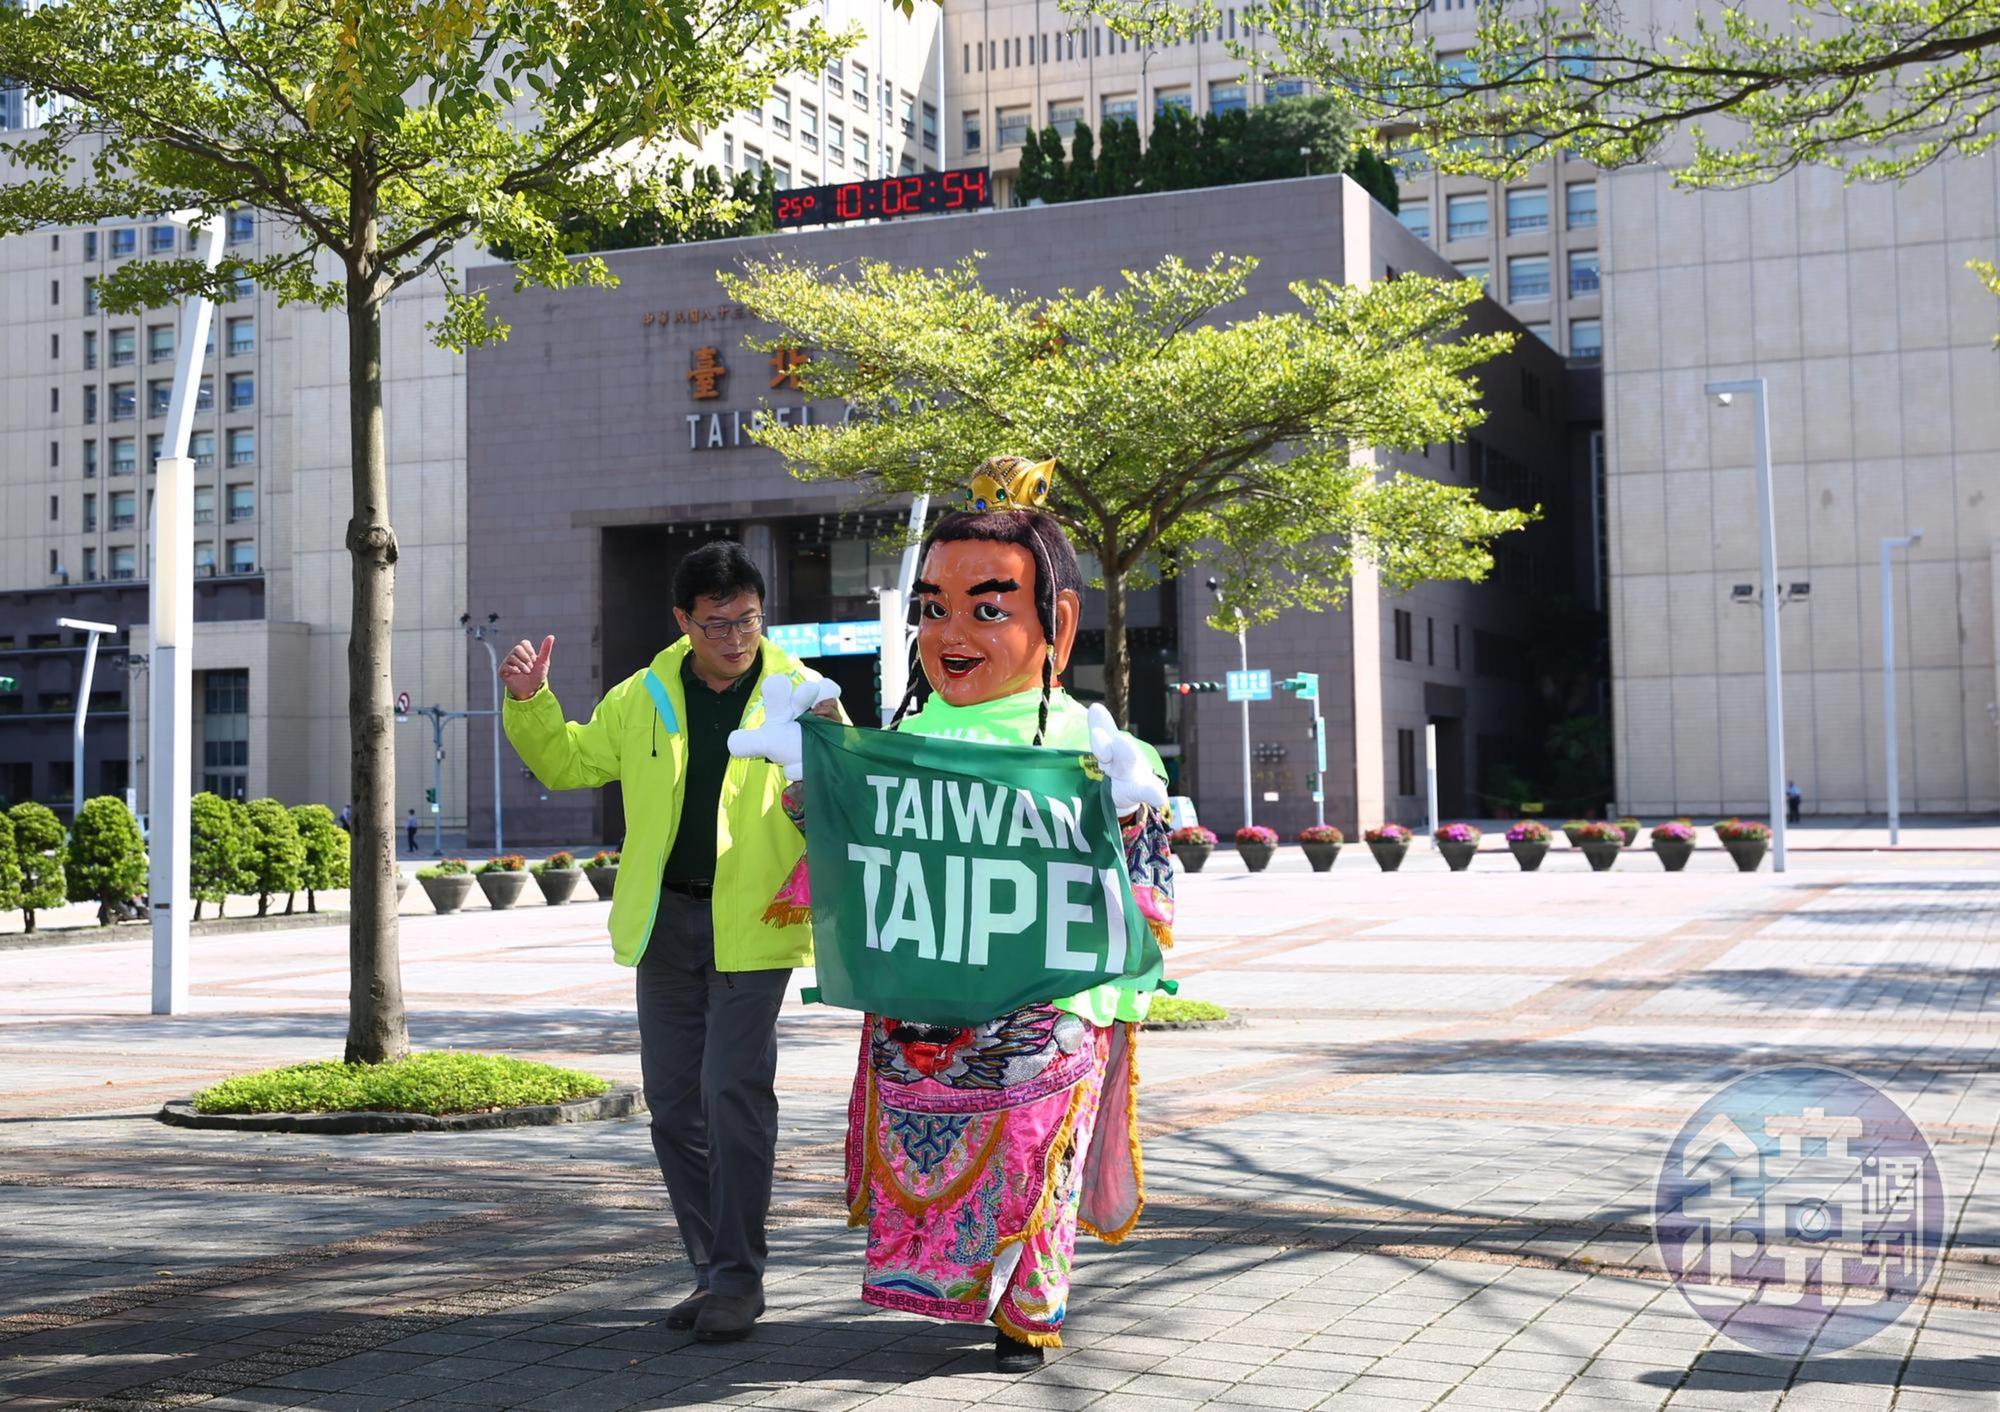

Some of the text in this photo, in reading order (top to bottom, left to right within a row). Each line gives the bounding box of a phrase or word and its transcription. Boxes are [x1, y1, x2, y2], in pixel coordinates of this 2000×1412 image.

[837, 171, 985, 219] 10:02:54
[866, 775, 1092, 853] TAIWAN
[847, 843, 1127, 974] TAIPEI
